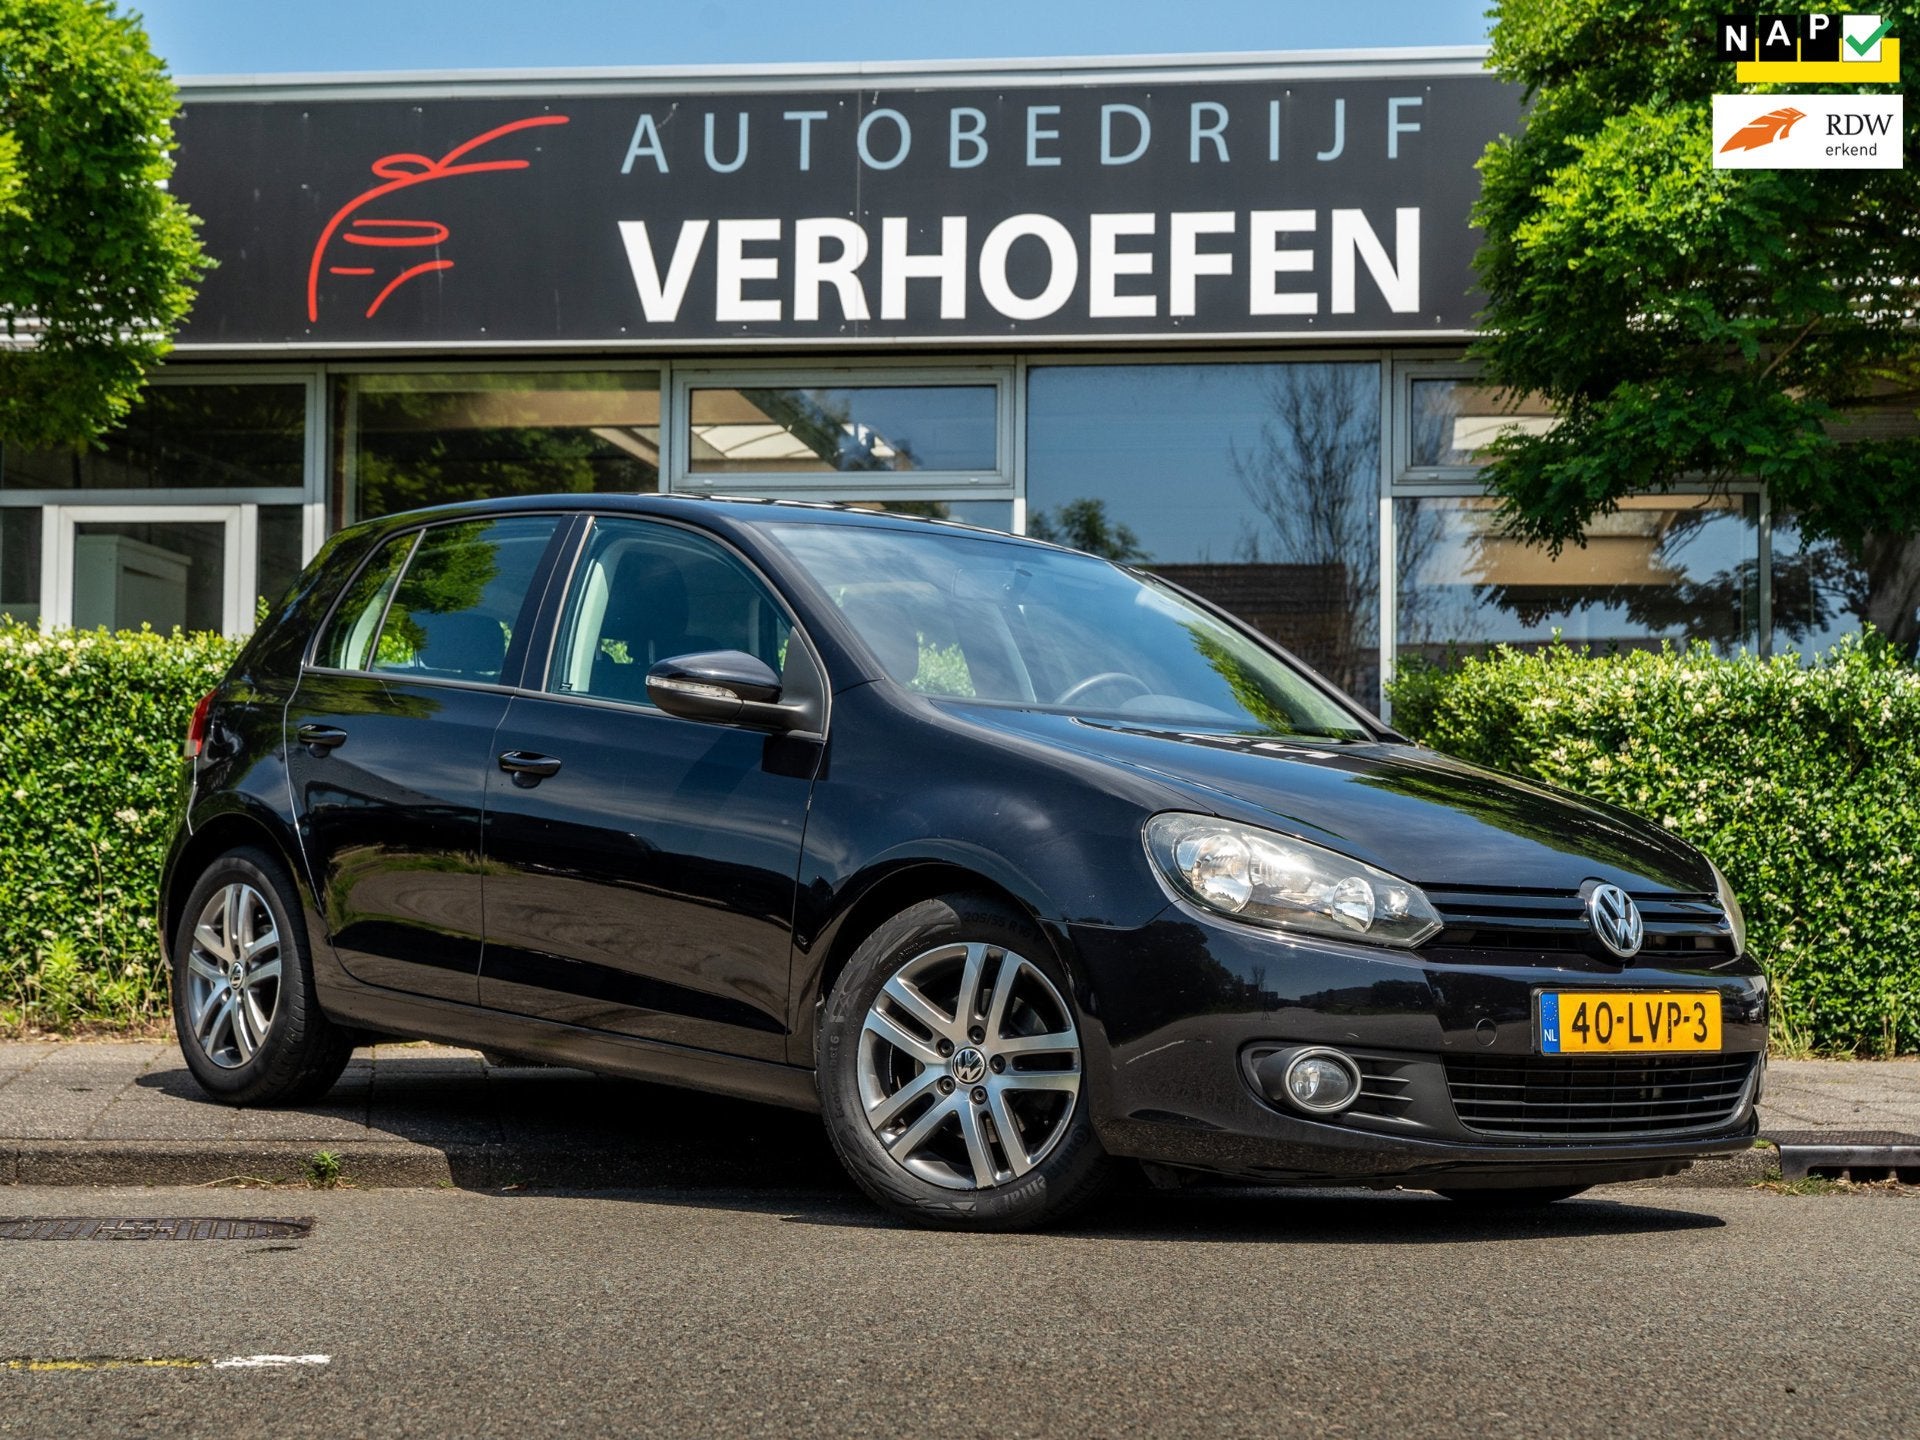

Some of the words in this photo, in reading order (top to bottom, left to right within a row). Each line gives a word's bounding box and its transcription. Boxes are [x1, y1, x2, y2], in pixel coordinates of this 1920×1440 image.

[620, 96, 1424, 175] AUTOBEDRIJF
[617, 207, 1421, 323] VERHOEFEN
[1543, 1028, 1558, 1043] NL
[1571, 1001, 1709, 1044] 40-LVP-3
